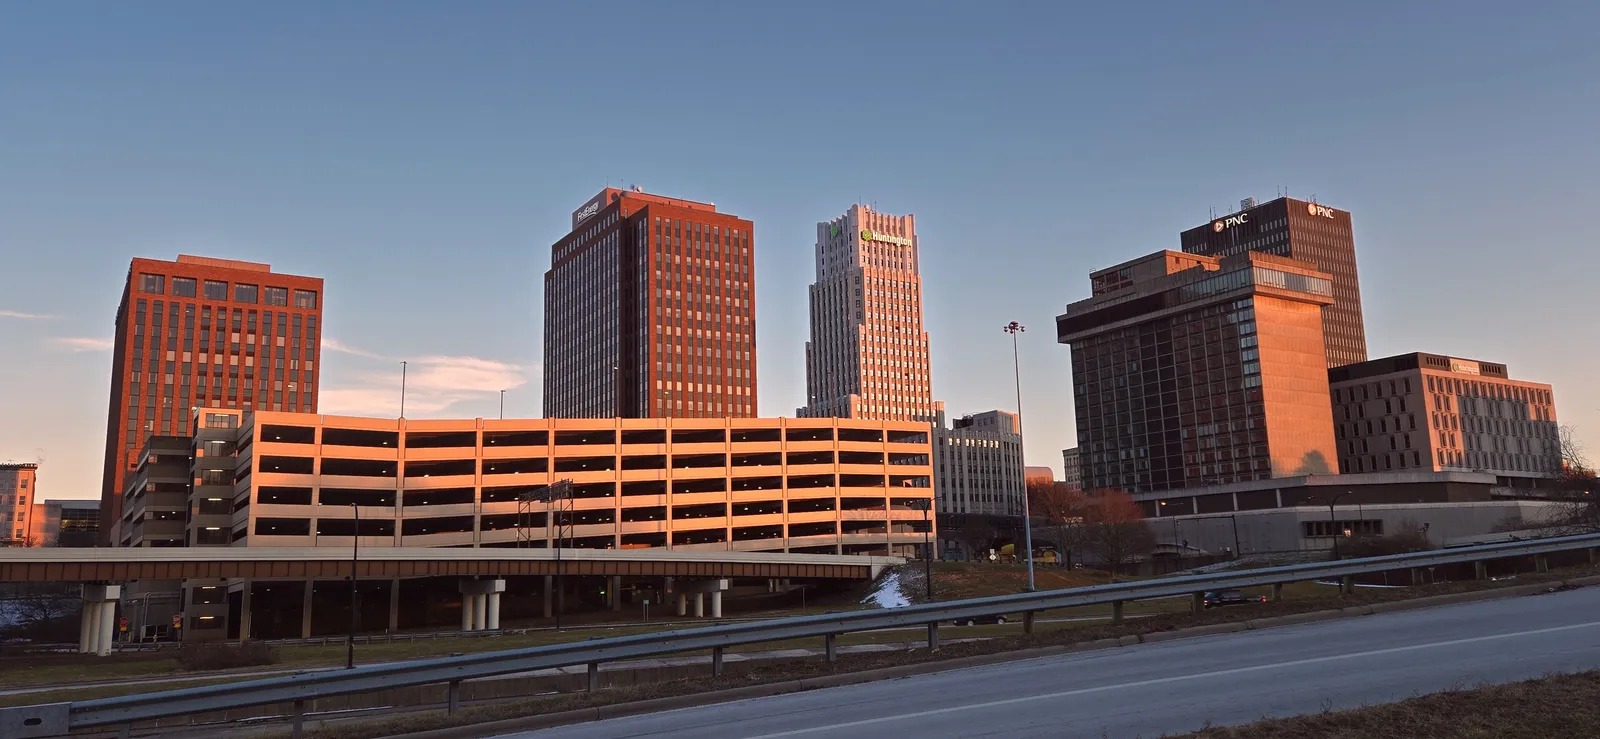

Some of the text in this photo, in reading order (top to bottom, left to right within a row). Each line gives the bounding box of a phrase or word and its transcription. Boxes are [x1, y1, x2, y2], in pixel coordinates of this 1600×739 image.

[1316, 207, 1334, 219] PNC
[1225, 213, 1248, 228] PNC
[872, 232, 911, 246] Huntington
